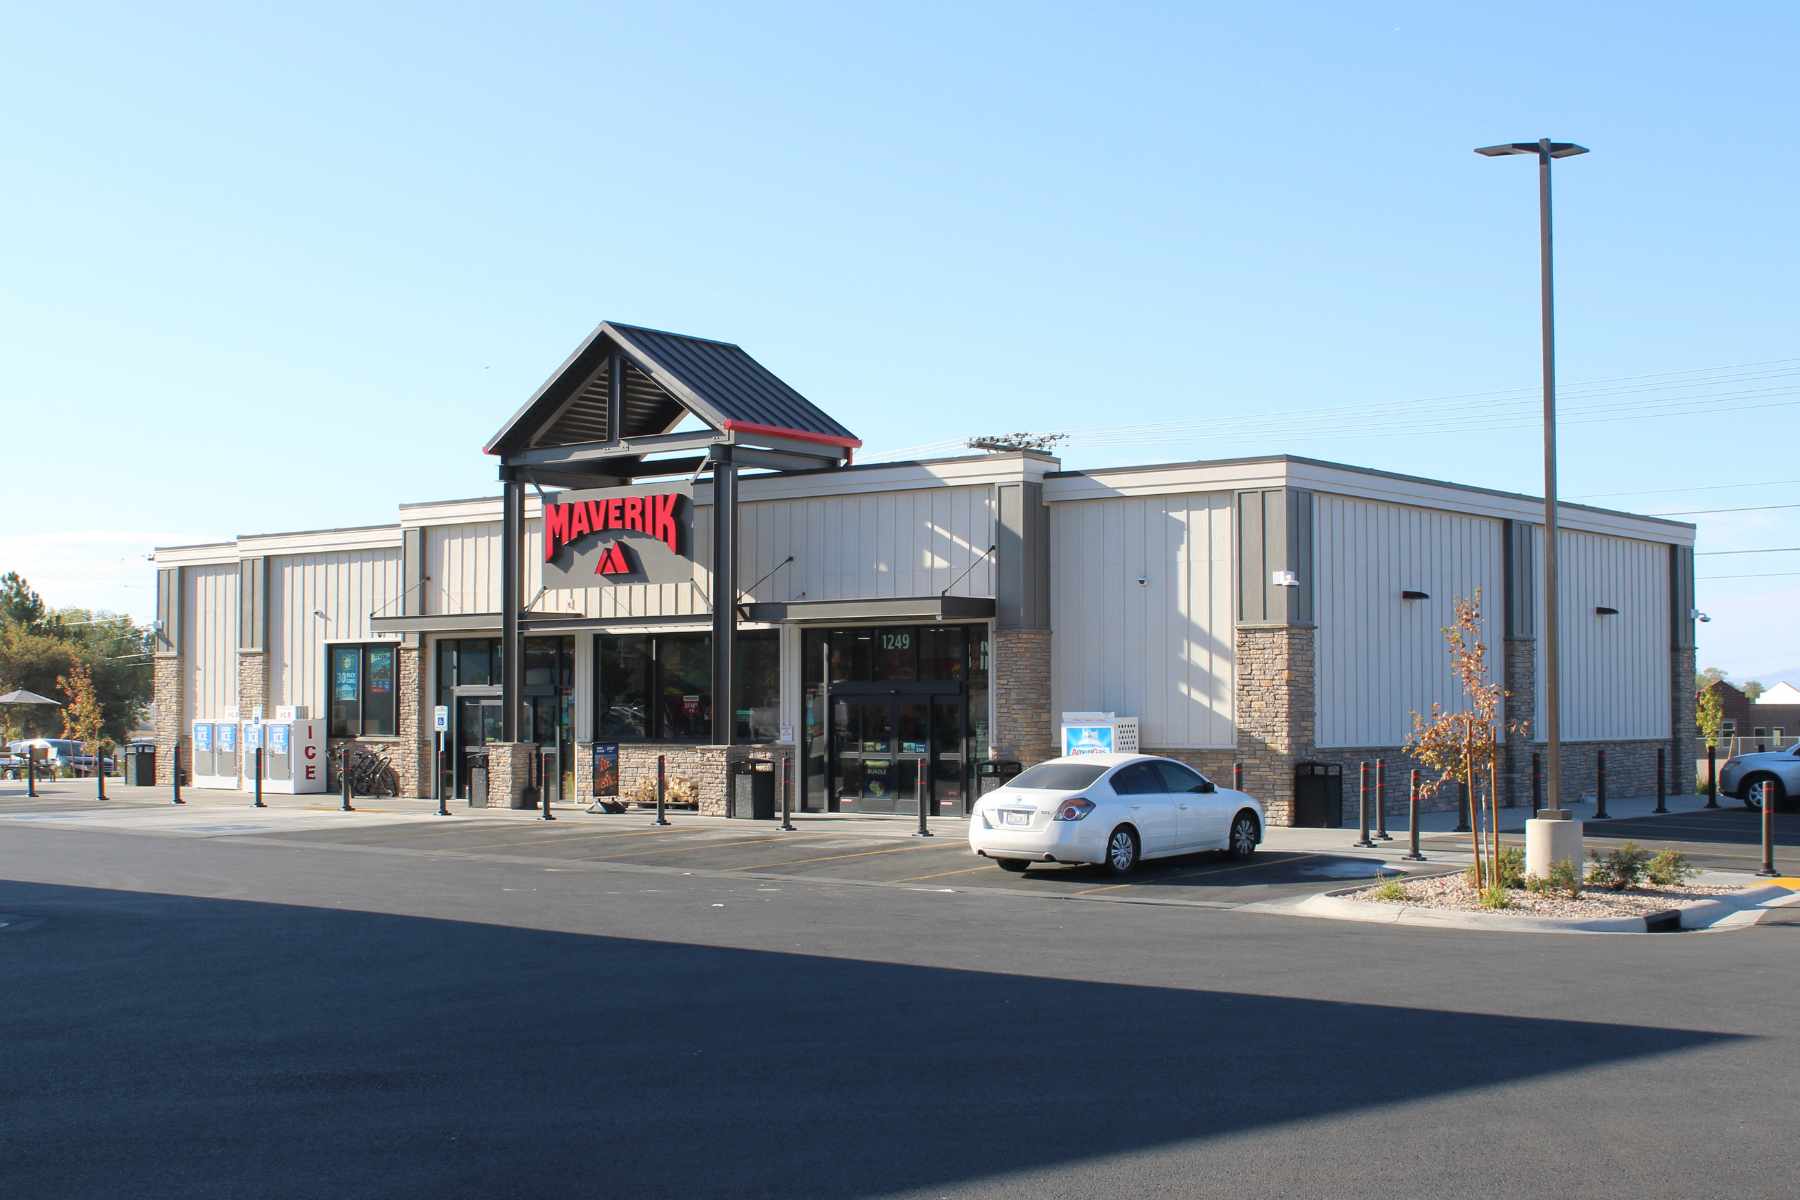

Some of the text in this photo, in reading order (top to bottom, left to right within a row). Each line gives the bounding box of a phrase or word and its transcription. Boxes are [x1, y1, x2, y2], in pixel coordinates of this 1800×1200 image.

[544, 492, 678, 563] MAVERIK
[882, 633, 911, 650] 1249
[304, 725, 316, 780] ICE
